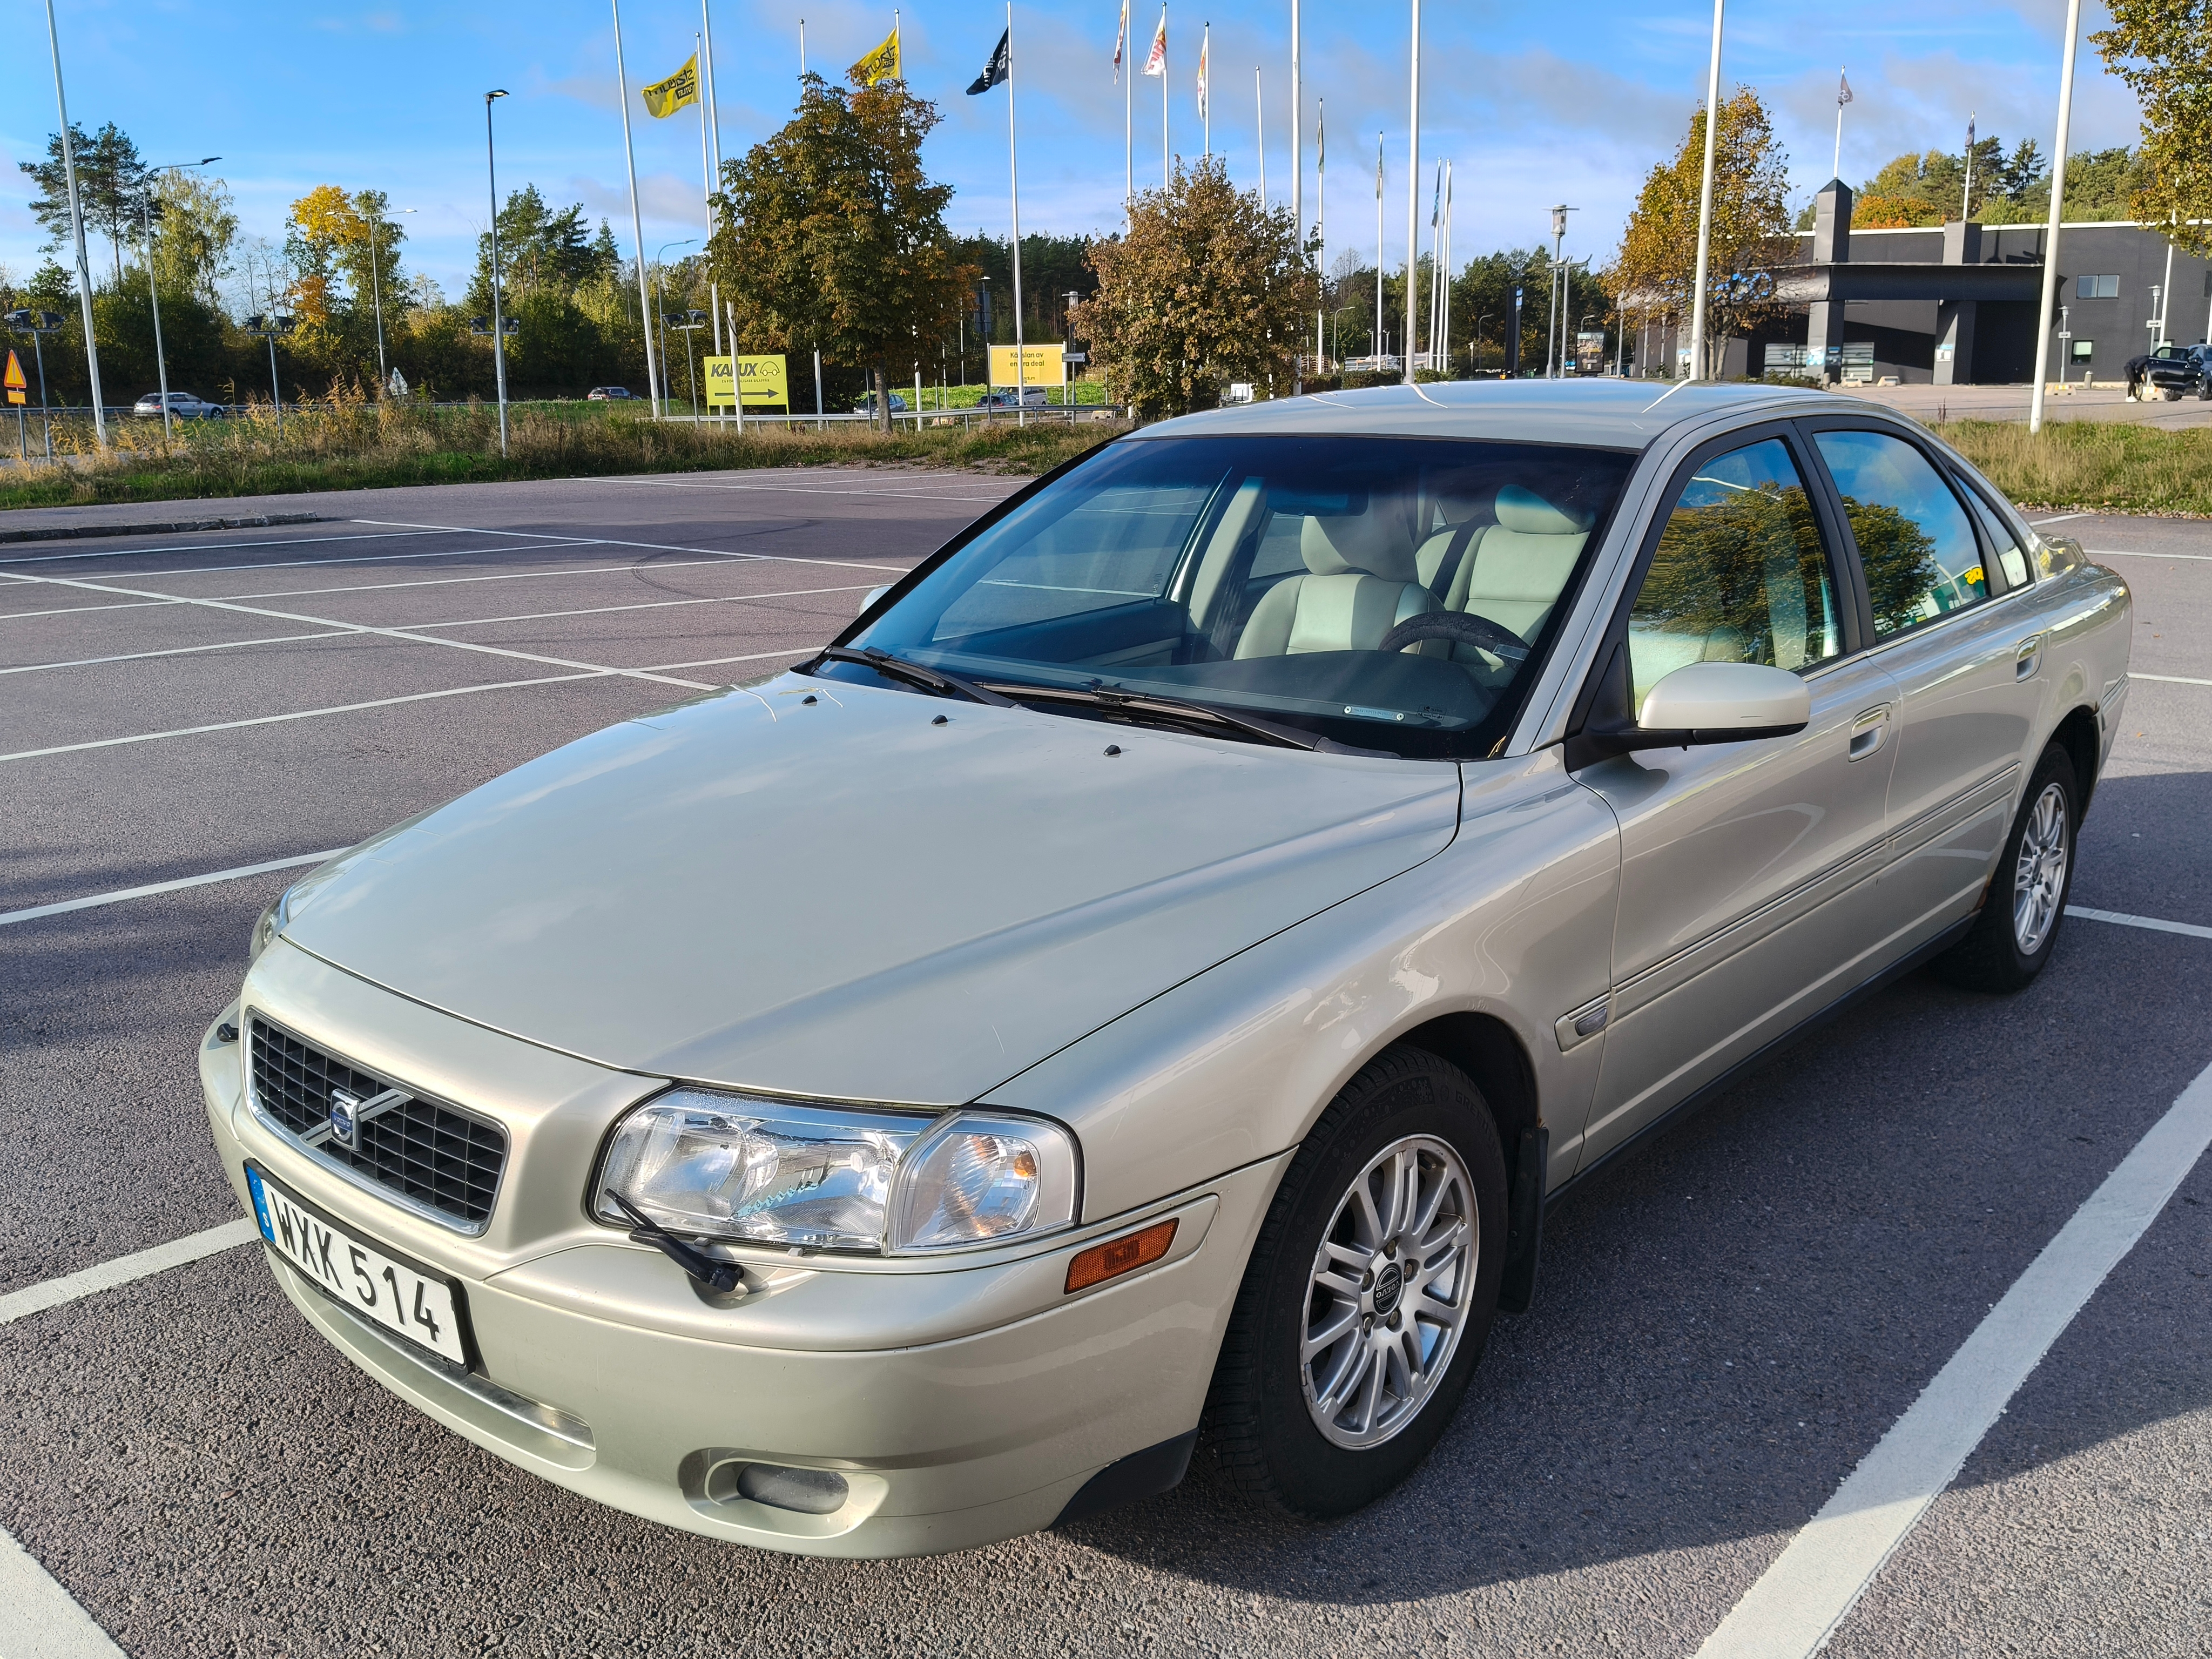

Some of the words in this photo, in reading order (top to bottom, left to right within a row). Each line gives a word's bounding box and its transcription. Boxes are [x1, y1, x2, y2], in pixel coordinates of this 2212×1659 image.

[711, 363, 758, 377] KAUX
[333, 1115, 350, 1127] VOLVO
[262, 1212, 270, 1228] S
[271, 1190, 344, 1291] WXK
[347, 1243, 440, 1343] 514
[1376, 1281, 1400, 1298] VOLVO
